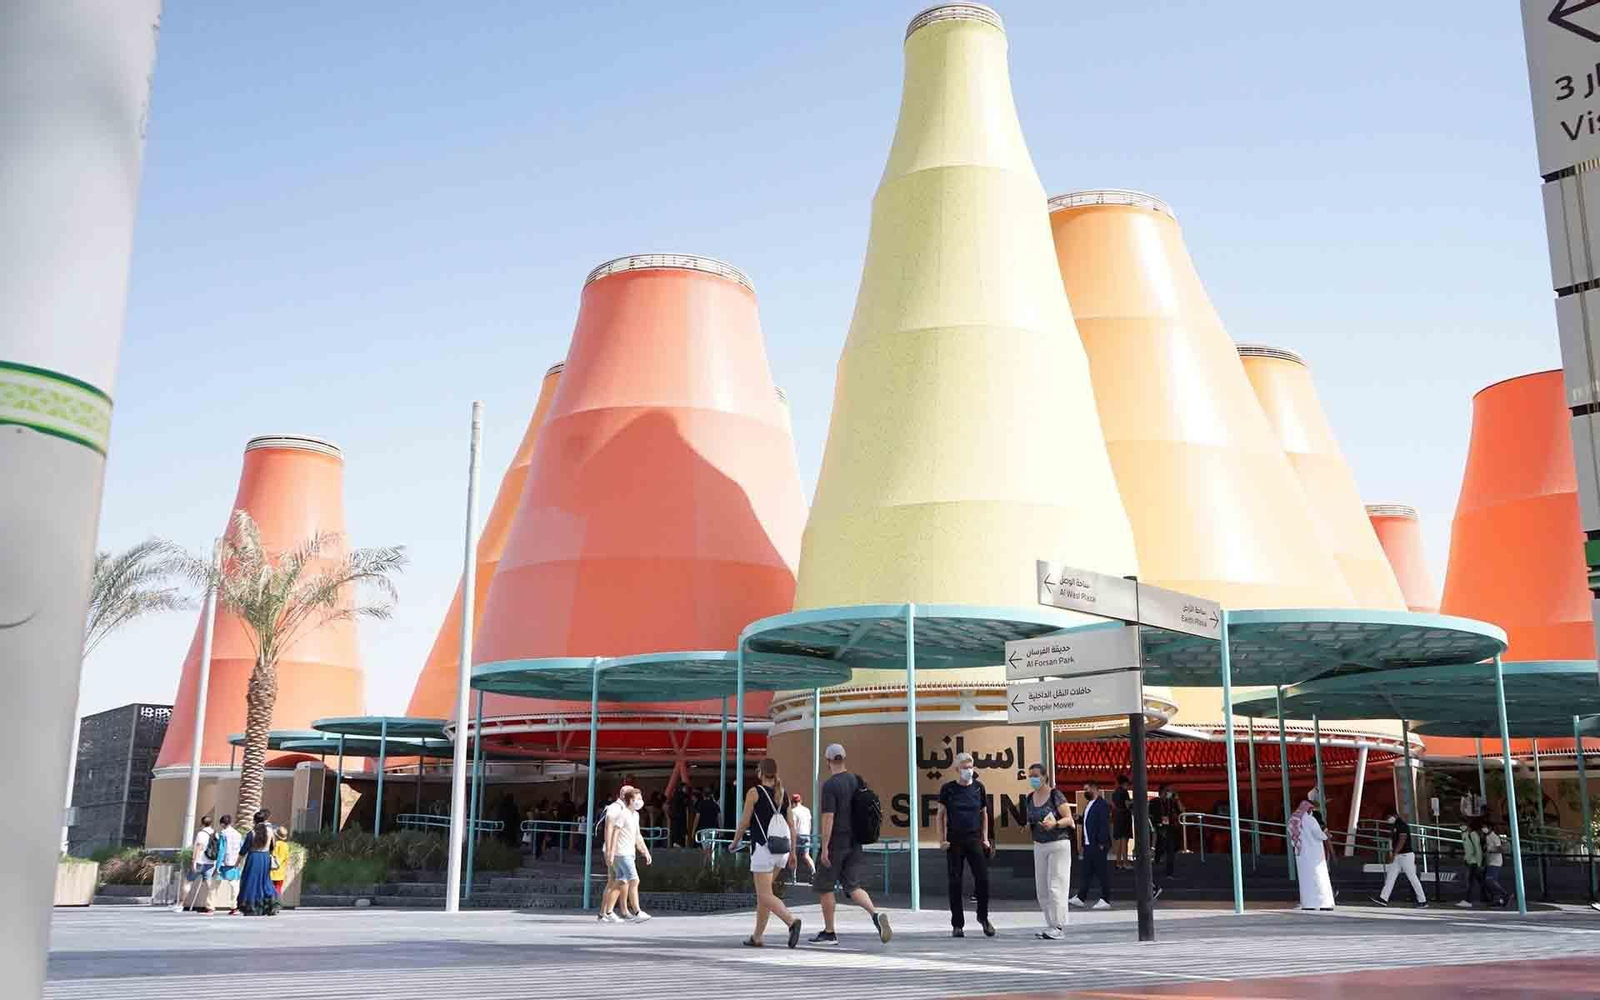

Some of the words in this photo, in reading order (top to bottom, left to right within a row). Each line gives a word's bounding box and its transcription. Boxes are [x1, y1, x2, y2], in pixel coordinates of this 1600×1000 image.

[1555, 75, 1574, 100] 3
[1560, 110, 1600, 140] Vi
[1026, 646, 1050, 658] الفرسان
[1051, 644, 1071, 655] حديقة
[1026, 660, 1034, 668] Al
[1034, 658, 1058, 667] Forsan
[1058, 655, 1075, 665] Park
[1028, 690, 1051, 701] الداخلية
[1052, 688, 1069, 699] النقل
[1070, 686, 1092, 696] حافلات
[1028, 704, 1052, 713] People
[1052, 701, 1075, 710] Mover
[891, 793, 1028, 828] SPIN
